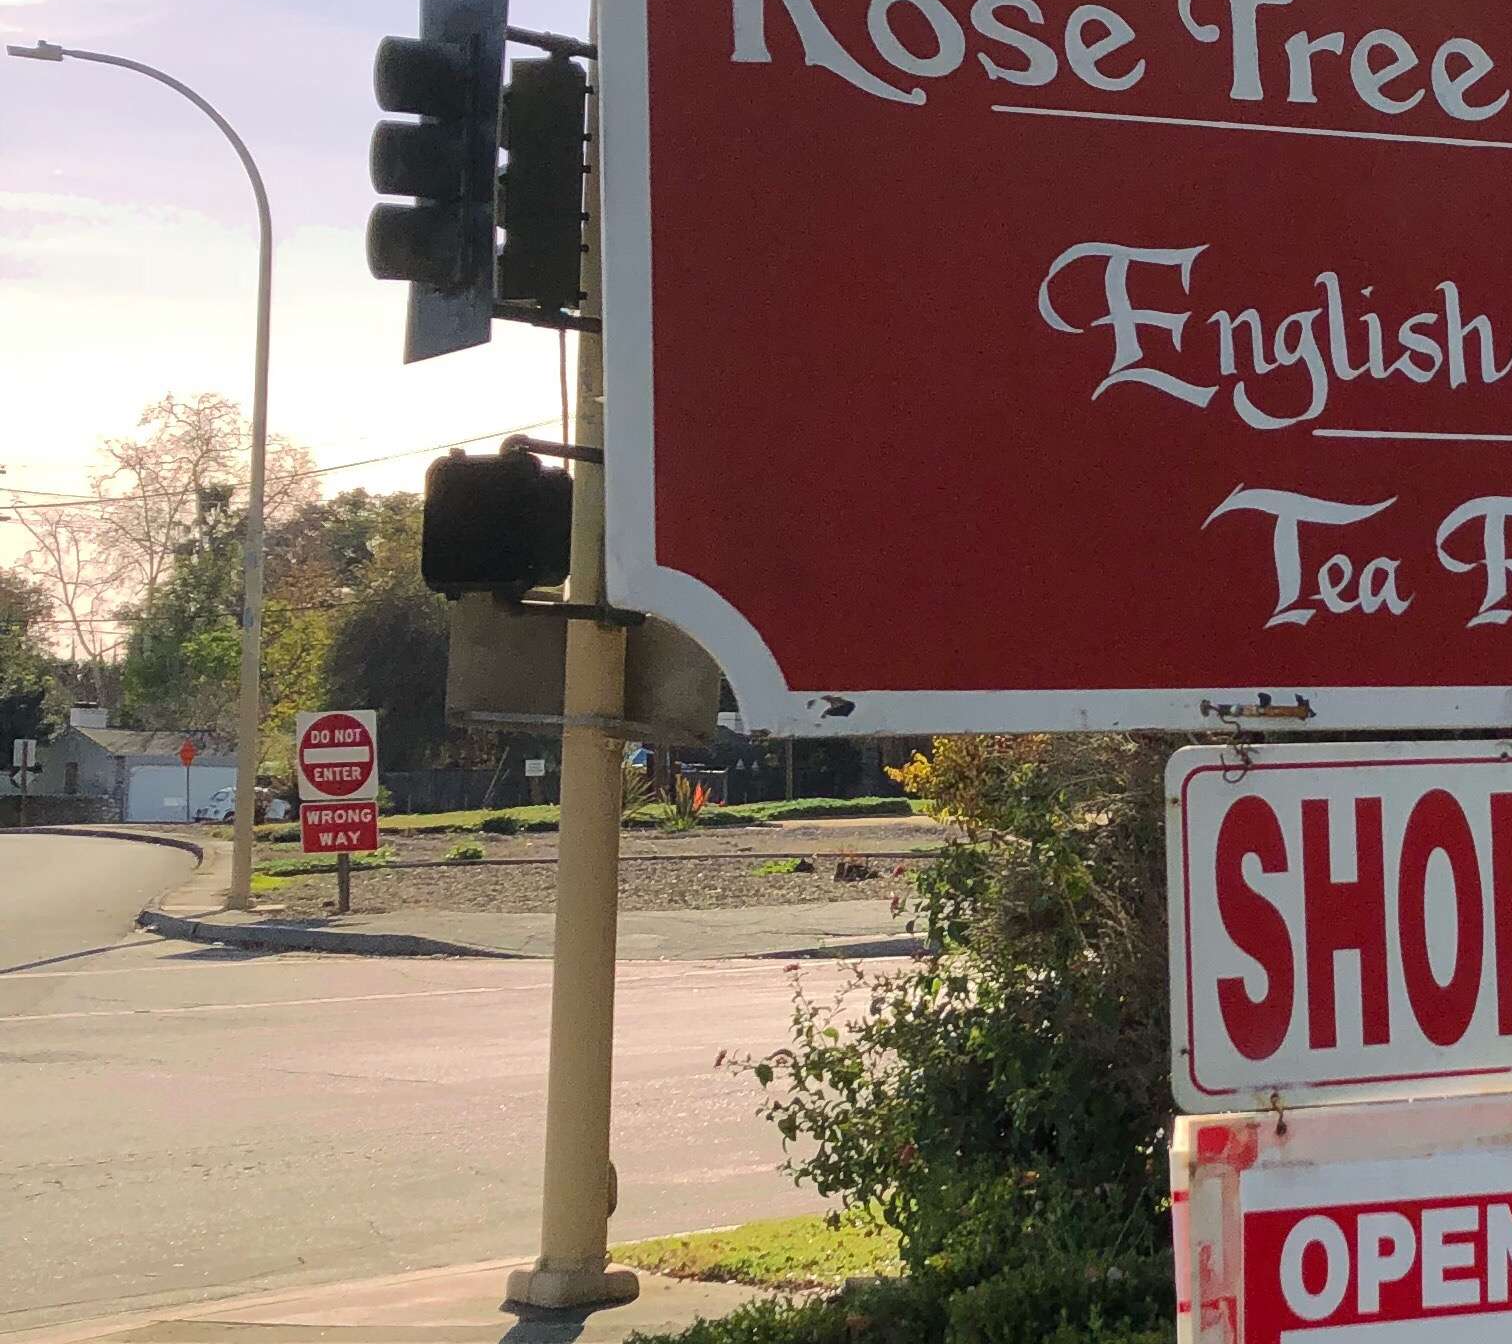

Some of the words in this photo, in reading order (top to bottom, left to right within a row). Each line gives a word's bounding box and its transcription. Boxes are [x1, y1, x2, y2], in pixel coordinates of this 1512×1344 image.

[1200, 482, 1412, 629] Tea
[311, 730, 330, 743] DO
[335, 728, 362, 743] NOT
[313, 766, 362, 782] ENTER
[306, 808, 373, 825] WRONG
[319, 830, 361, 846] WAY
